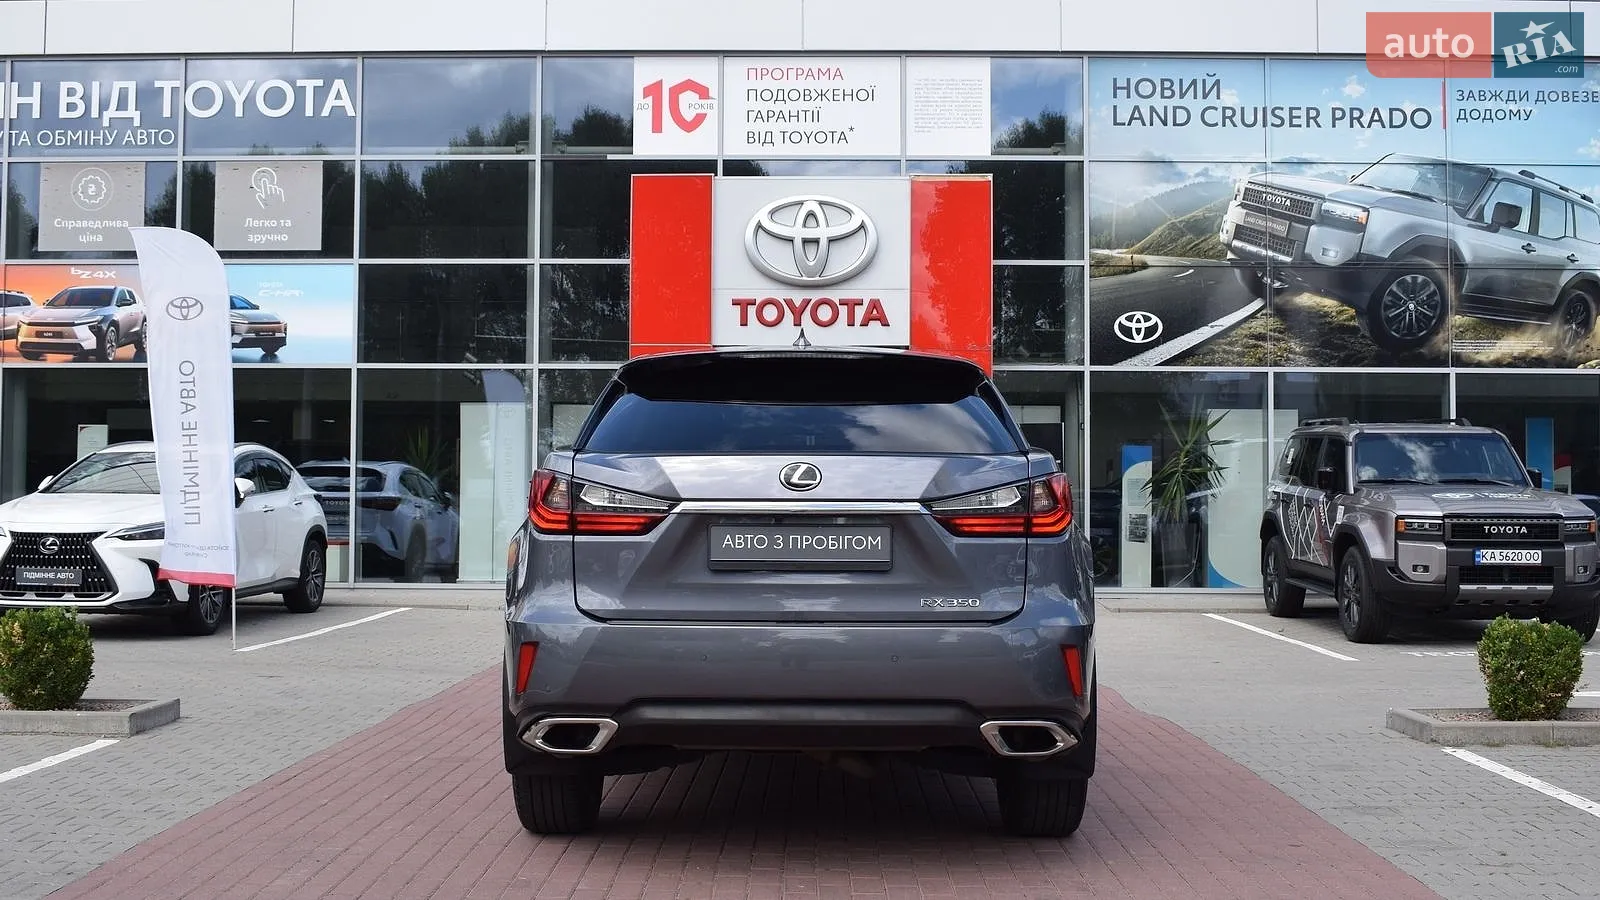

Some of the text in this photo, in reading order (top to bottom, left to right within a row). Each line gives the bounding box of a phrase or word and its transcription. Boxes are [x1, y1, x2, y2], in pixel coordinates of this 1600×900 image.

[747, 67, 844, 81] ПРОГРАМА
[1113, 73, 1221, 100] НОВИЙ
[59, 80, 141, 127] ВІД
[154, 78, 356, 118] TOYOTA
[747, 85, 876, 105] ПОДОВЖЕНОЇ
[1456, 89, 1529, 104] ЗАВЖДИ
[637, 102, 650, 111] ДО
[688, 102, 714, 111] РОКІВ
[747, 106, 821, 123] ГАРАНТІЇ
[1112, 105, 1432, 130] LAND CRUISER PRADO
[1456, 108, 1533, 123] ДОДОМУ
[10, 130, 31, 146] ТА
[37, 130, 118, 146] ОБМІНУ
[122, 129, 175, 146] АВТО
[747, 131, 775, 147] ВІД
[1262, 193, 1291, 206] TOYOTA
[54, 218, 129, 229] Справедлива
[244, 218, 292, 228] Легко та
[79, 232, 104, 243] ціна
[247, 233, 289, 243] зручно
[731, 297, 890, 328] TOYOTA
[1483, 526, 1528, 534] TOYOTA
[722, 534, 768, 549] АВТО
[789, 535, 882, 550] ПРОБІГОМ
[1481, 551, 1497, 562] KA
[1499, 551, 1523, 562] 5620
[23, 571, 56, 579] ПІДМІННЕ
